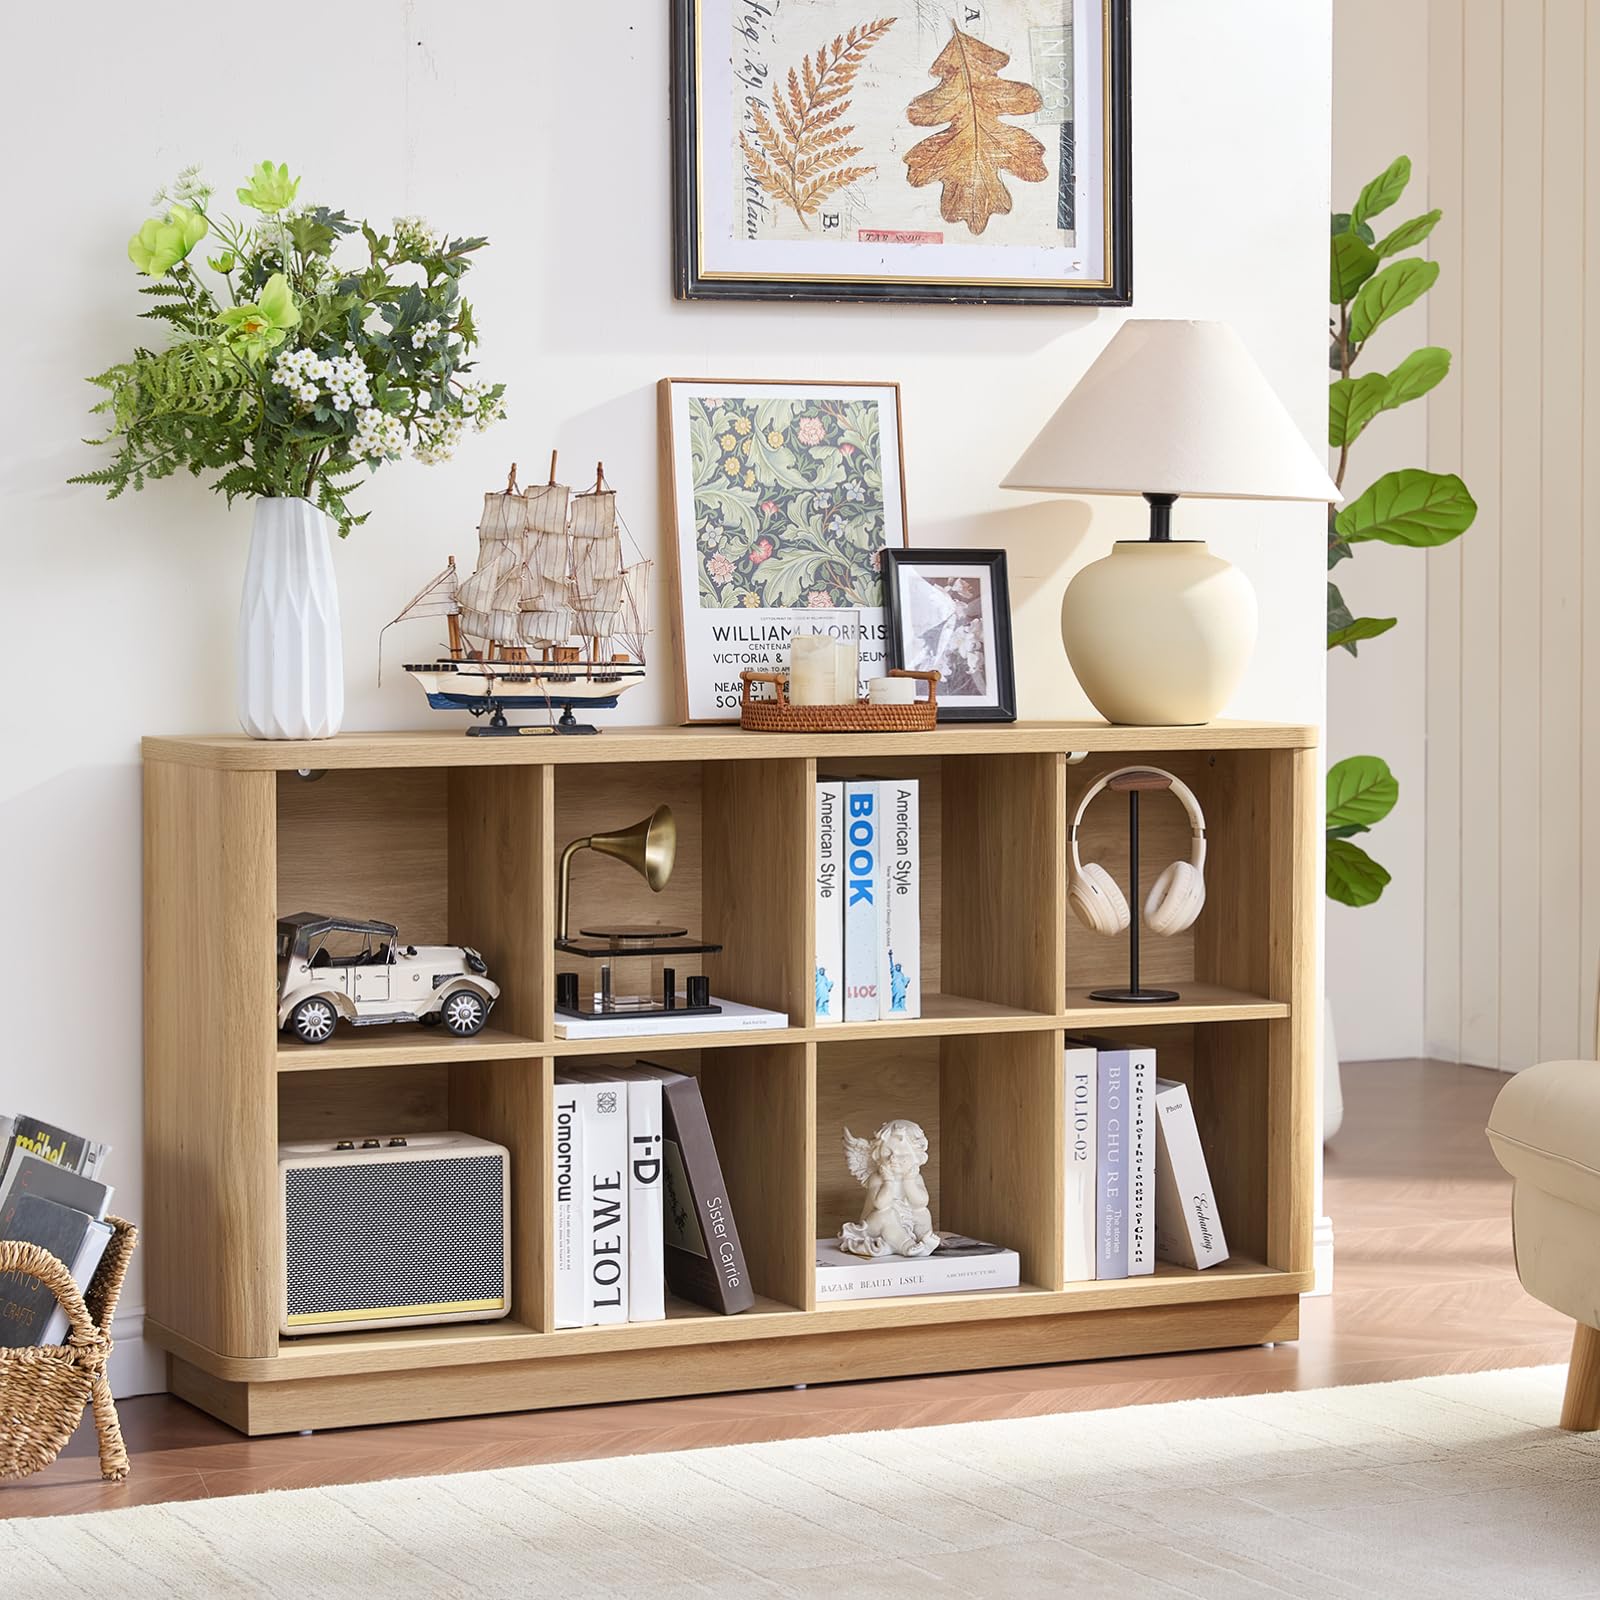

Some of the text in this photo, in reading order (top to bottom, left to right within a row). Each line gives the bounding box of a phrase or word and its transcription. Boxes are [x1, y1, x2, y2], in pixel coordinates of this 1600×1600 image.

[713, 653, 769, 664] VICTORIA
[775, 652, 783, 663] &
[749, 643, 792, 651] CENTENAR
[714, 681, 765, 692] NEARST
[817, 792, 836, 898] American Style
[850, 794, 873, 906] BOOK
[893, 789, 911, 895] American Style
[1074, 1074, 1088, 1161] FOLIO-02
[1165, 1104, 1183, 1114] Photo
[558, 1100, 575, 1202] Tomorrow
[634, 1135, 661, 1184] i-D
[593, 1171, 621, 1308] LOEWE
[706, 1197, 740, 1288] Sister Carrie
[1105, 1204, 1111, 1213] of
[821, 1282, 854, 1293] BAZAAR
[860, 1278, 893, 1289] BEAUTY
[899, 1275, 925, 1285] ISSUE
